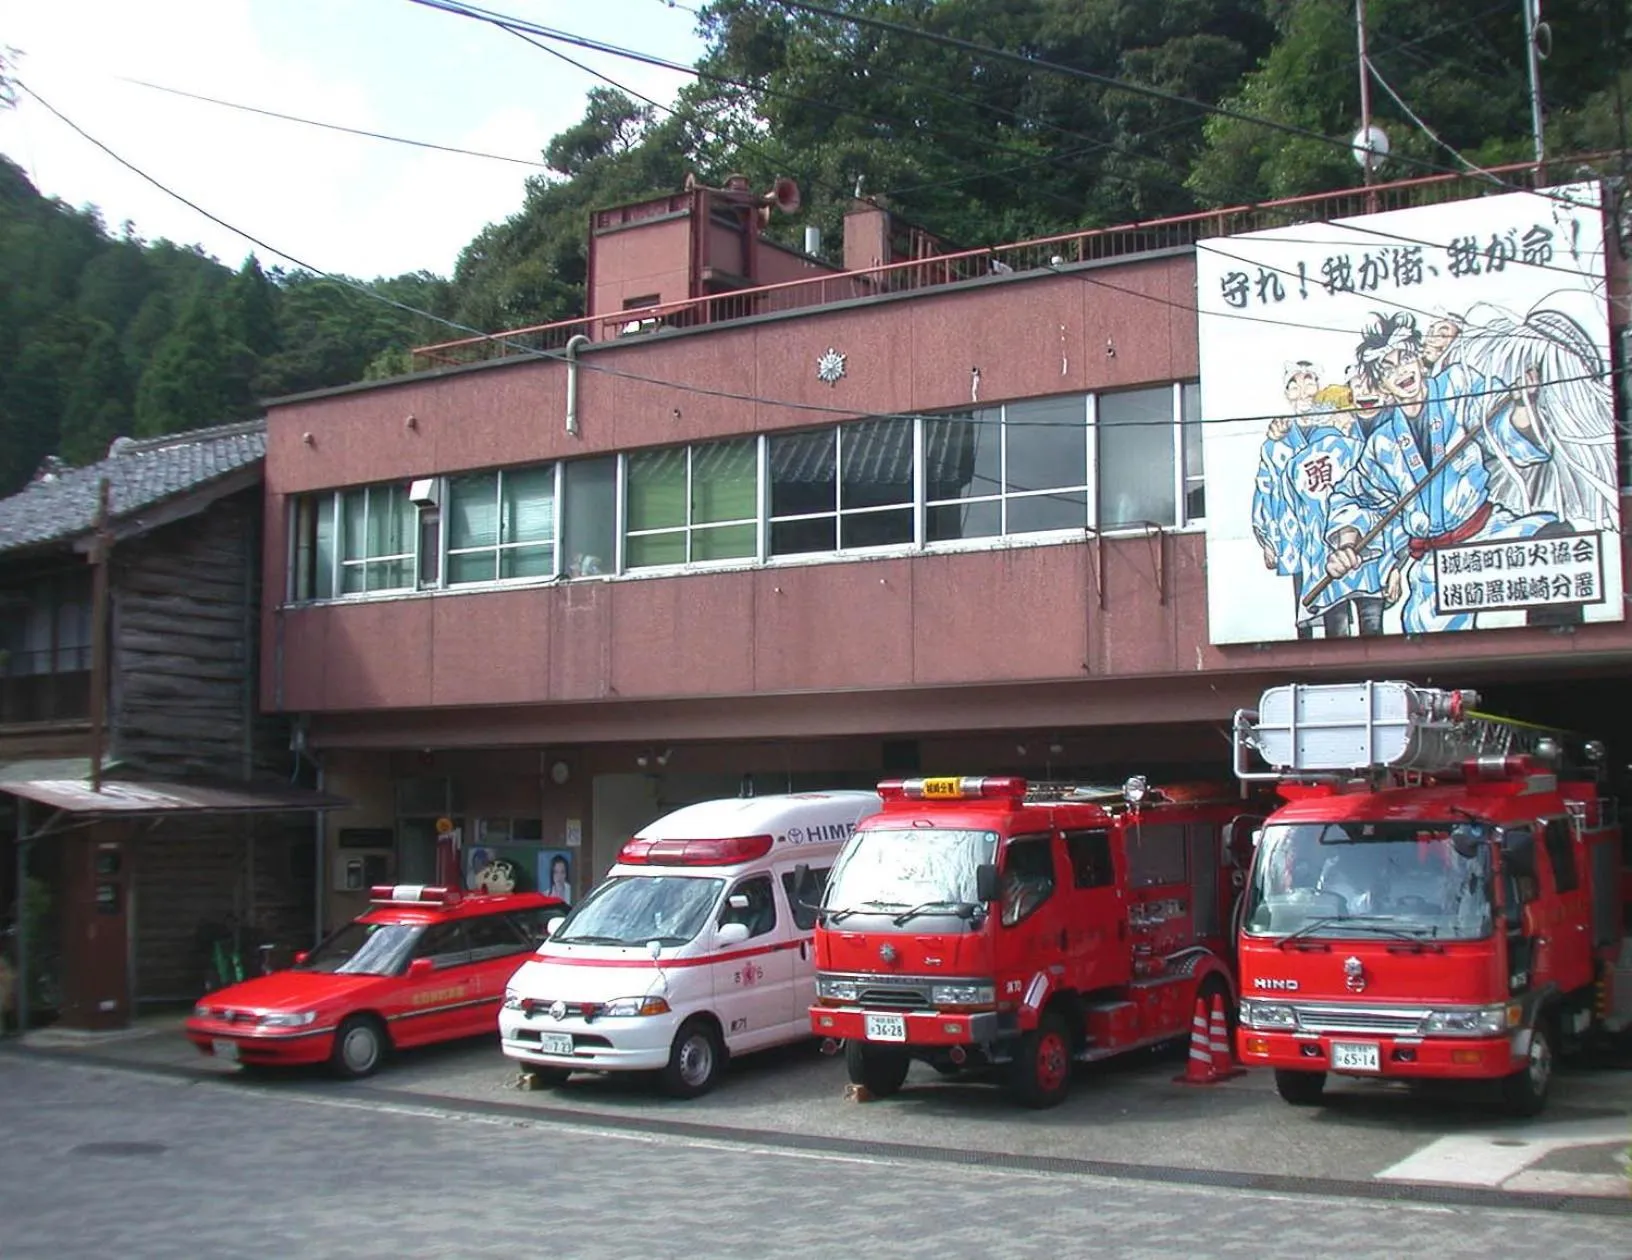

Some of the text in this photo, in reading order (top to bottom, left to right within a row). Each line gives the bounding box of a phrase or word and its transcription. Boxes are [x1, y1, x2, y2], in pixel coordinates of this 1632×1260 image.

[1303, 454, 1335, 493] 頭
[1440, 538, 1594, 575] 城崎町防火協会
[1443, 571, 1595, 607] 消防署城崎分署
[1253, 978, 1299, 990] HINO
[875, 1024, 904, 1037] 36-28
[1343, 1053, 1377, 1066] 65-14
